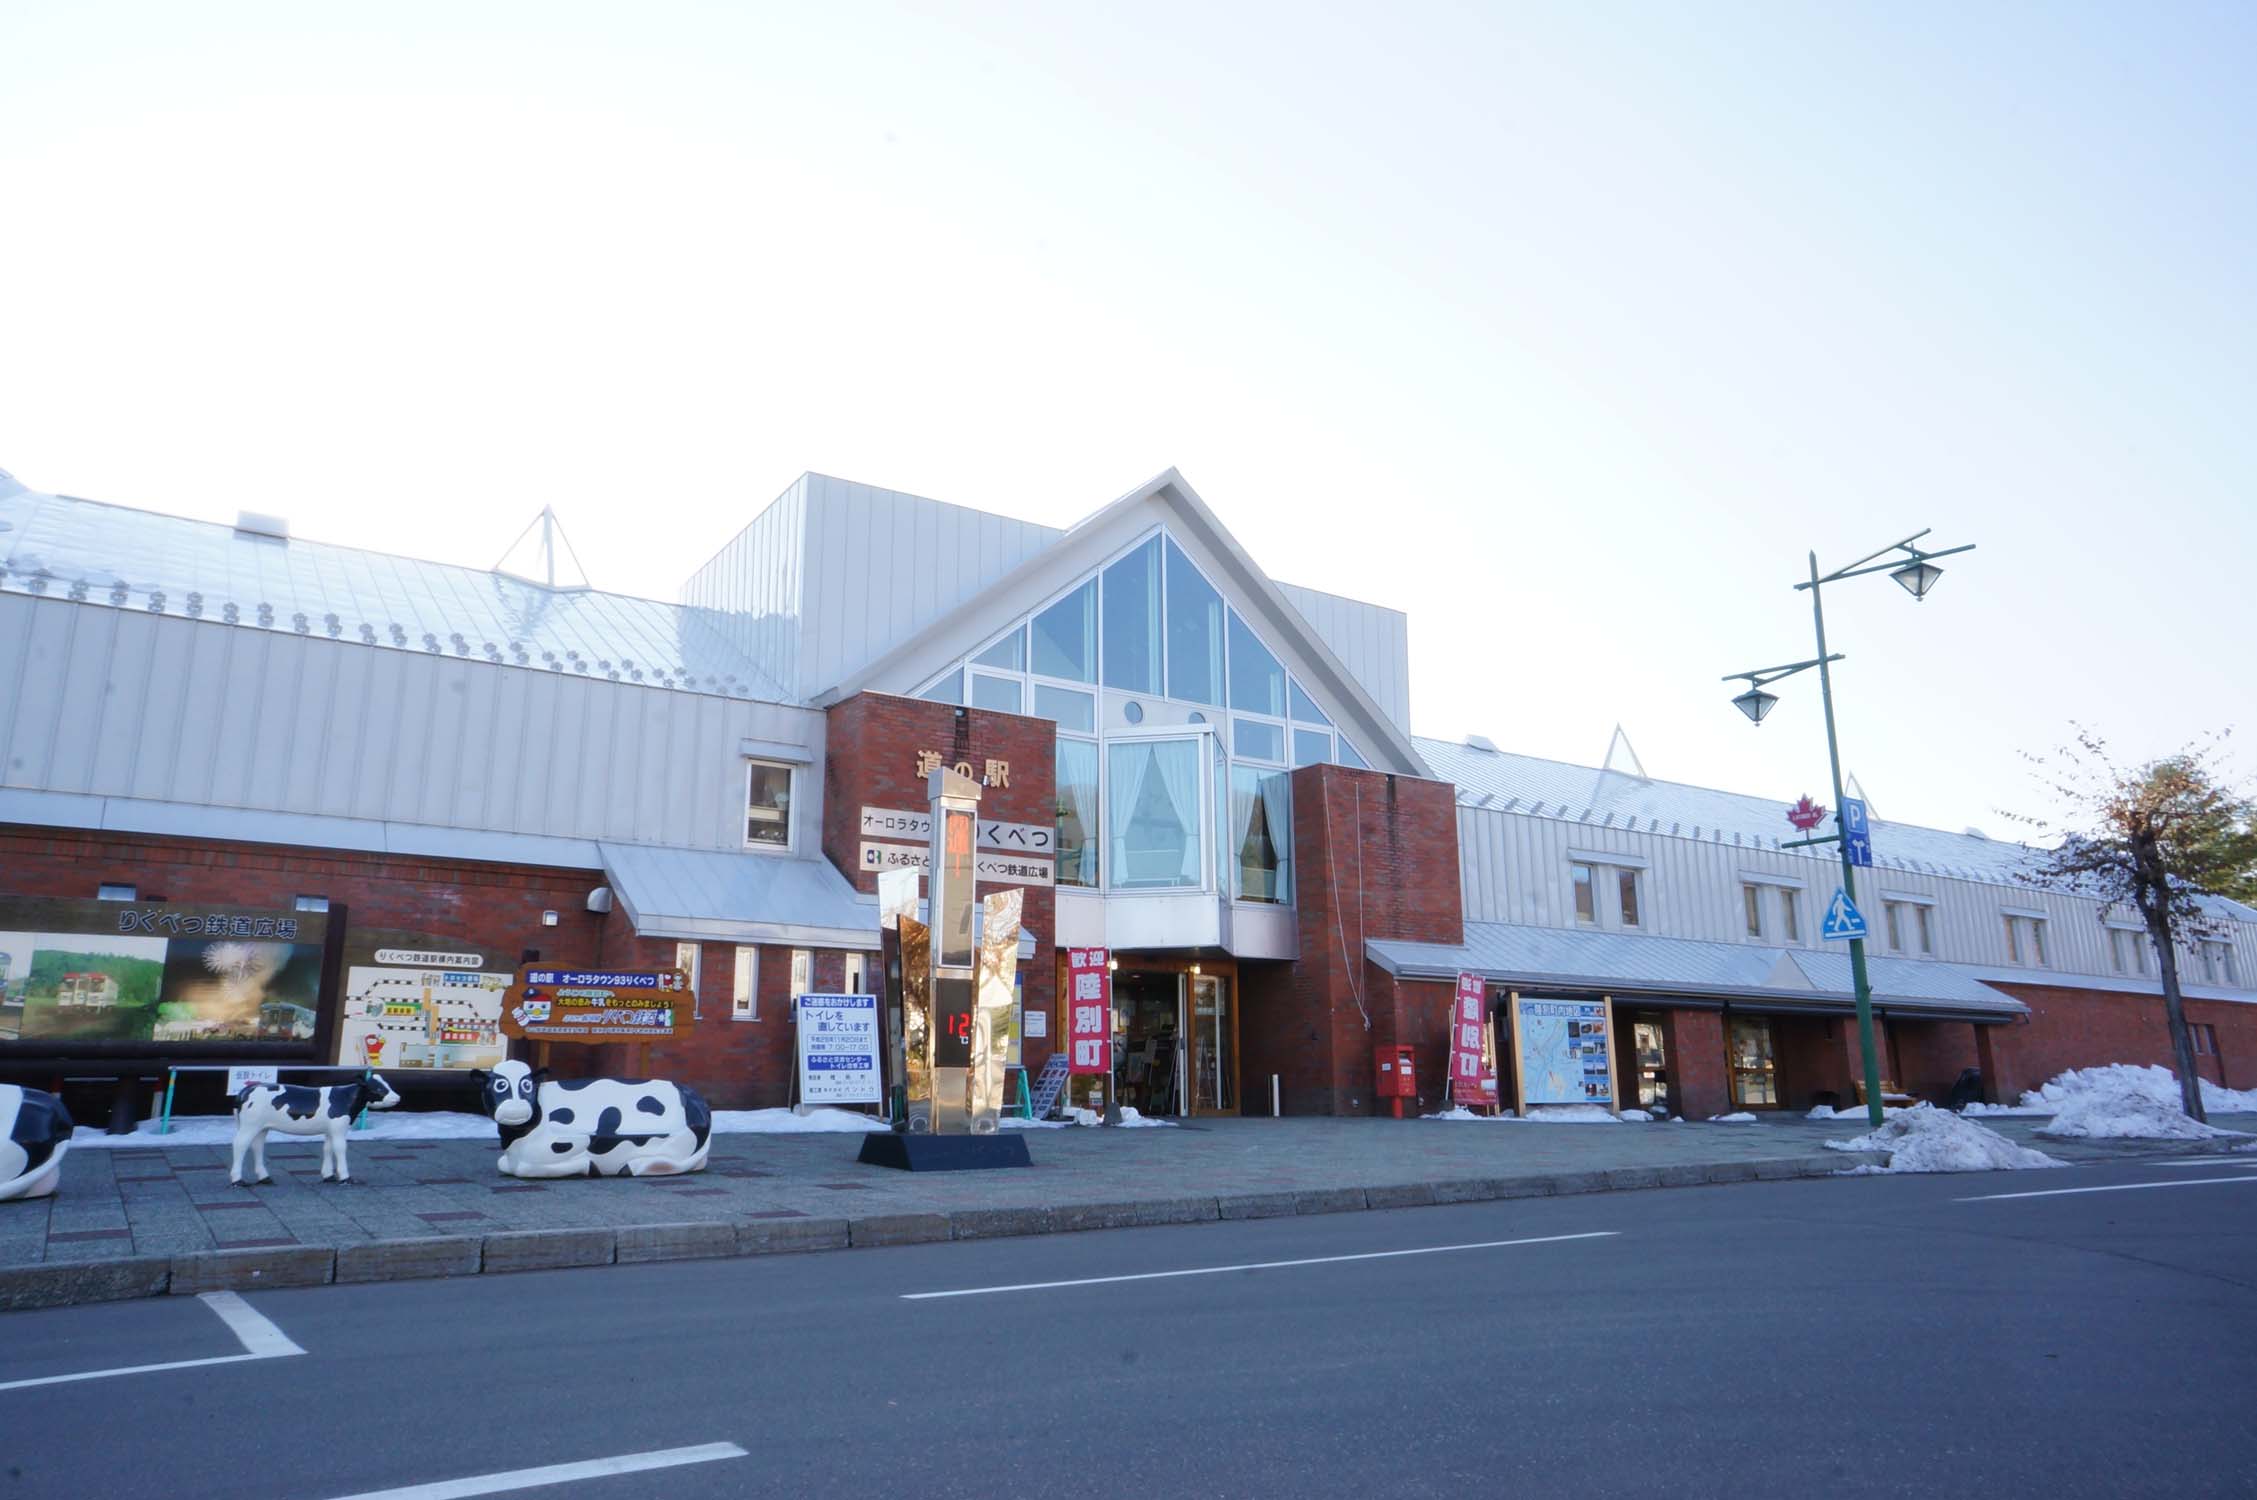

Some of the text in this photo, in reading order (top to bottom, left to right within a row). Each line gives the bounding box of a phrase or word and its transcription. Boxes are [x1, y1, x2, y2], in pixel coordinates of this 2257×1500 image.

[916, 750, 1010, 788] 道の駅
[119, 910, 298, 939] りくべつ鉄道広場
[1071, 951, 1105, 969] 歓迎
[562, 974, 656, 986] オーロラタウン93りくべつ
[805, 1010, 844, 1021] トイレを
[948, 1013, 971, 1036] 12
[1074, 972, 1103, 1066] 陸別町
[817, 1022, 870, 1032] 直しています
